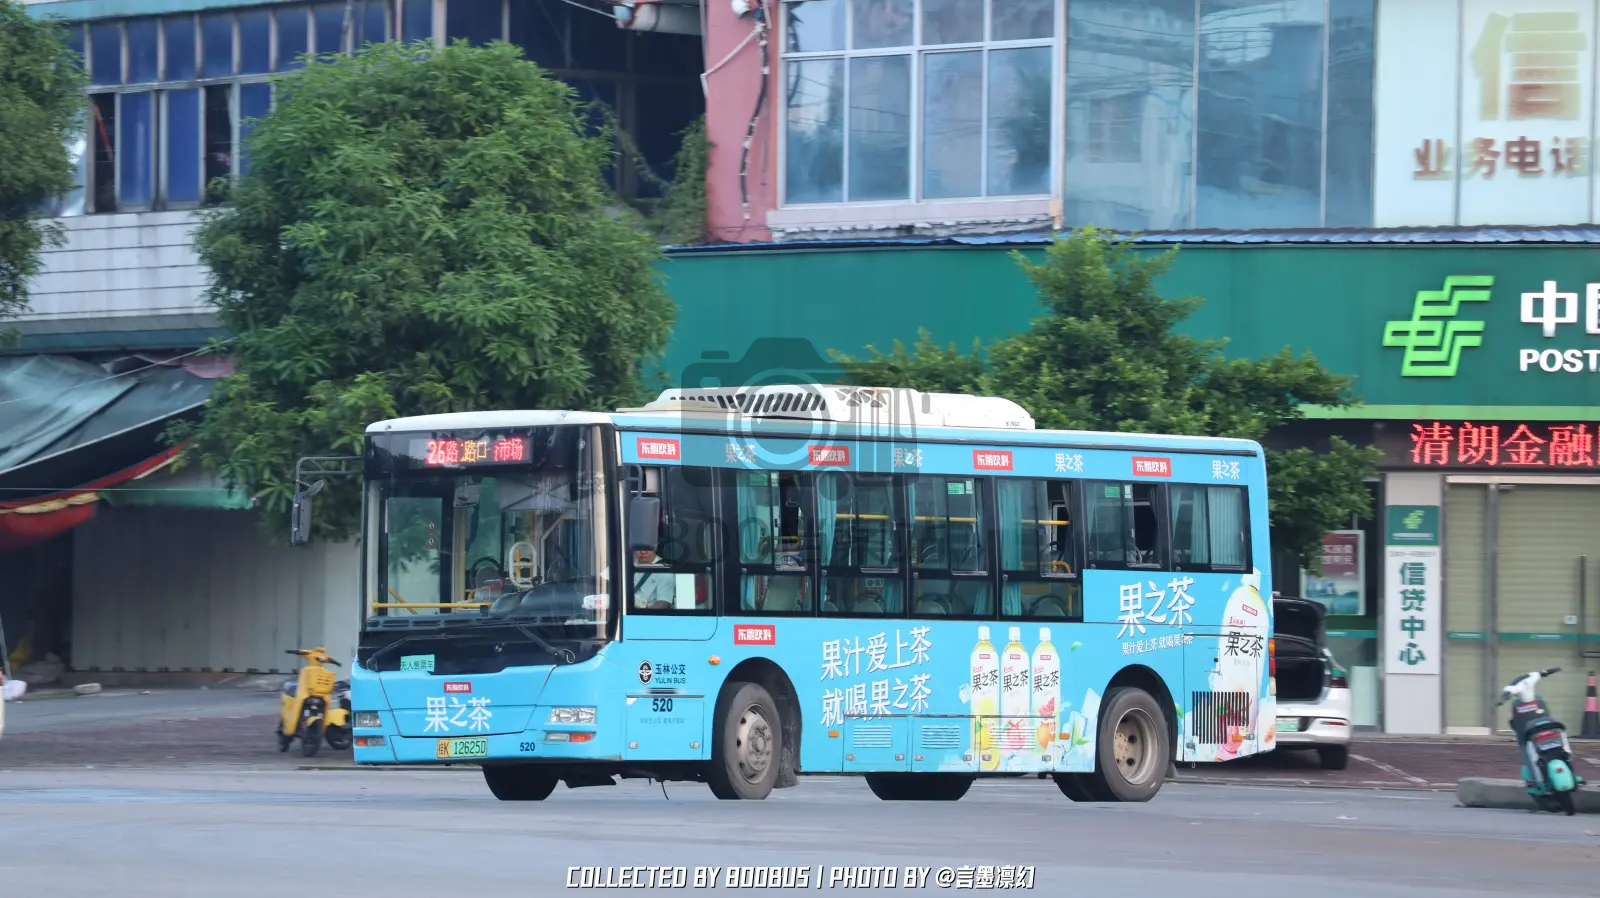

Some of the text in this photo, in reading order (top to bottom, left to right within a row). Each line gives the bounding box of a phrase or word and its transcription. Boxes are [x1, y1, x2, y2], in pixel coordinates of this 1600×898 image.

[1412, 136, 1588, 180] 业务电话
[1520, 280, 1600, 337] 中
[1520, 348, 1600, 373] POST
[1409, 421, 1600, 467] 清朗金融
[1055, 452, 1084, 472] 果之茶
[1211, 460, 1240, 480] 果之茶
[1117, 576, 1196, 639] 果之茶
[1399, 561, 1427, 666] 信贷中心
[821, 625, 932, 681] 果汁爱上茶
[655, 663, 686, 675] 玉林公交
[972, 669, 998, 694] 果之茶
[1003, 669, 1028, 693] 果之茶
[1033, 670, 1059, 694] 果之茶
[652, 697, 673, 712] 520
[820, 672, 932, 728] 就喝果之茶
[423, 696, 492, 733] 果之茶
[519, 742, 535, 752] 520
